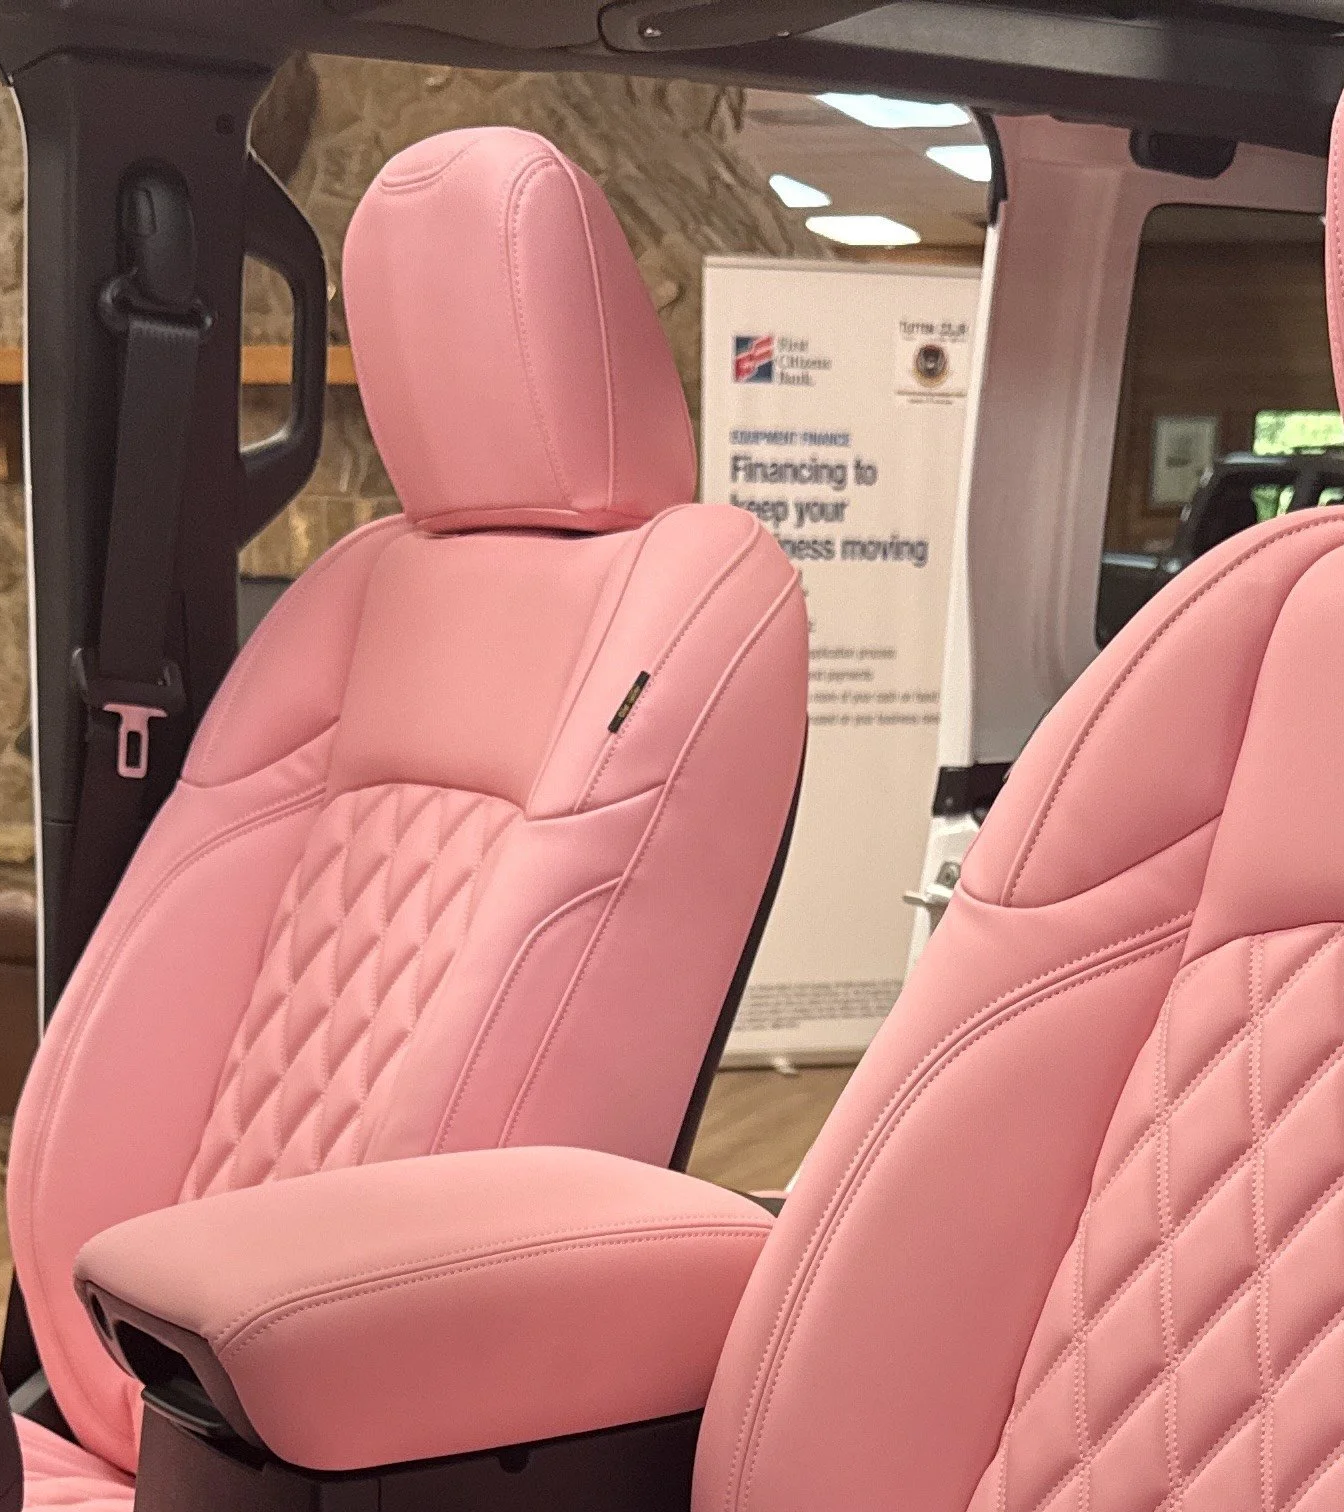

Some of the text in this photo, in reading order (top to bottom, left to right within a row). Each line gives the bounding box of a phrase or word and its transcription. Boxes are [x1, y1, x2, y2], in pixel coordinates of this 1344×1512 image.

[730, 454, 878, 491] Financing to
[730, 492, 849, 528] eep your
[841, 532, 929, 568] moving
